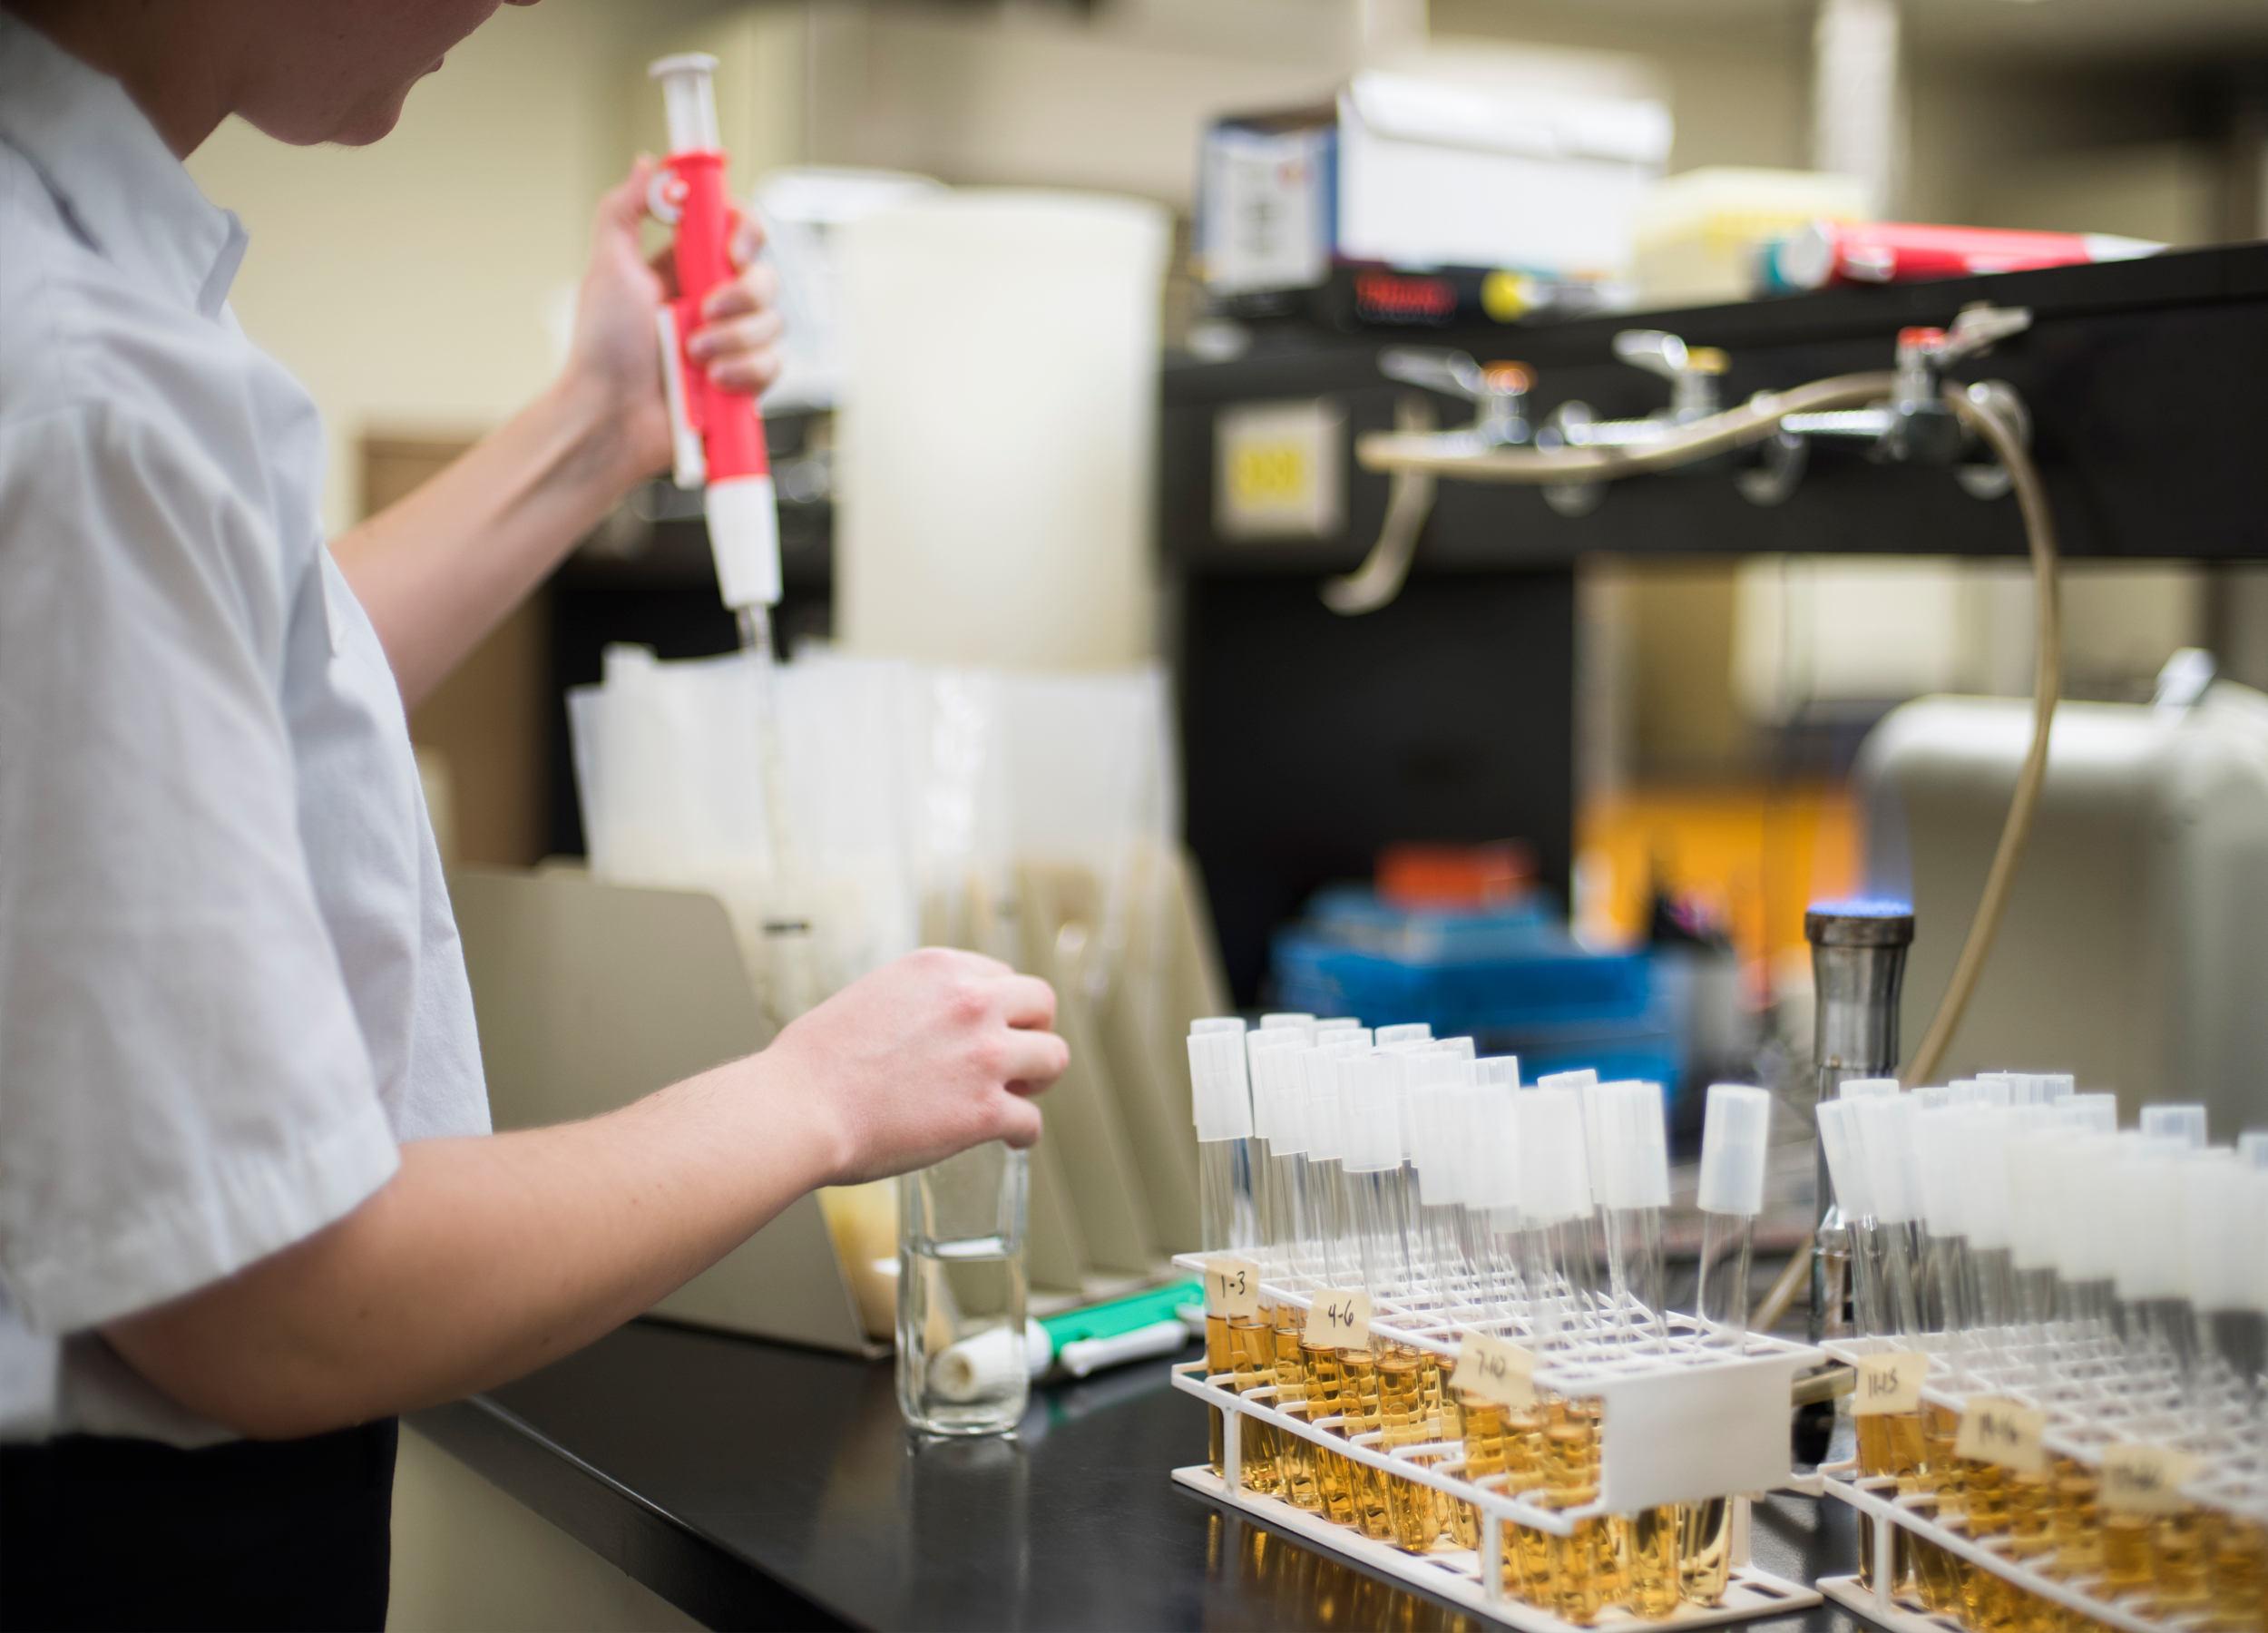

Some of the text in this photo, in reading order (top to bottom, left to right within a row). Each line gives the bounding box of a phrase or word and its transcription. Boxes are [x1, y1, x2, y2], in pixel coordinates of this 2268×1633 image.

[1220, 1270, 1246, 1299] 1-3
[1327, 1299, 1354, 1328] 4-6
[1475, 1348, 1507, 1379] 7-10
